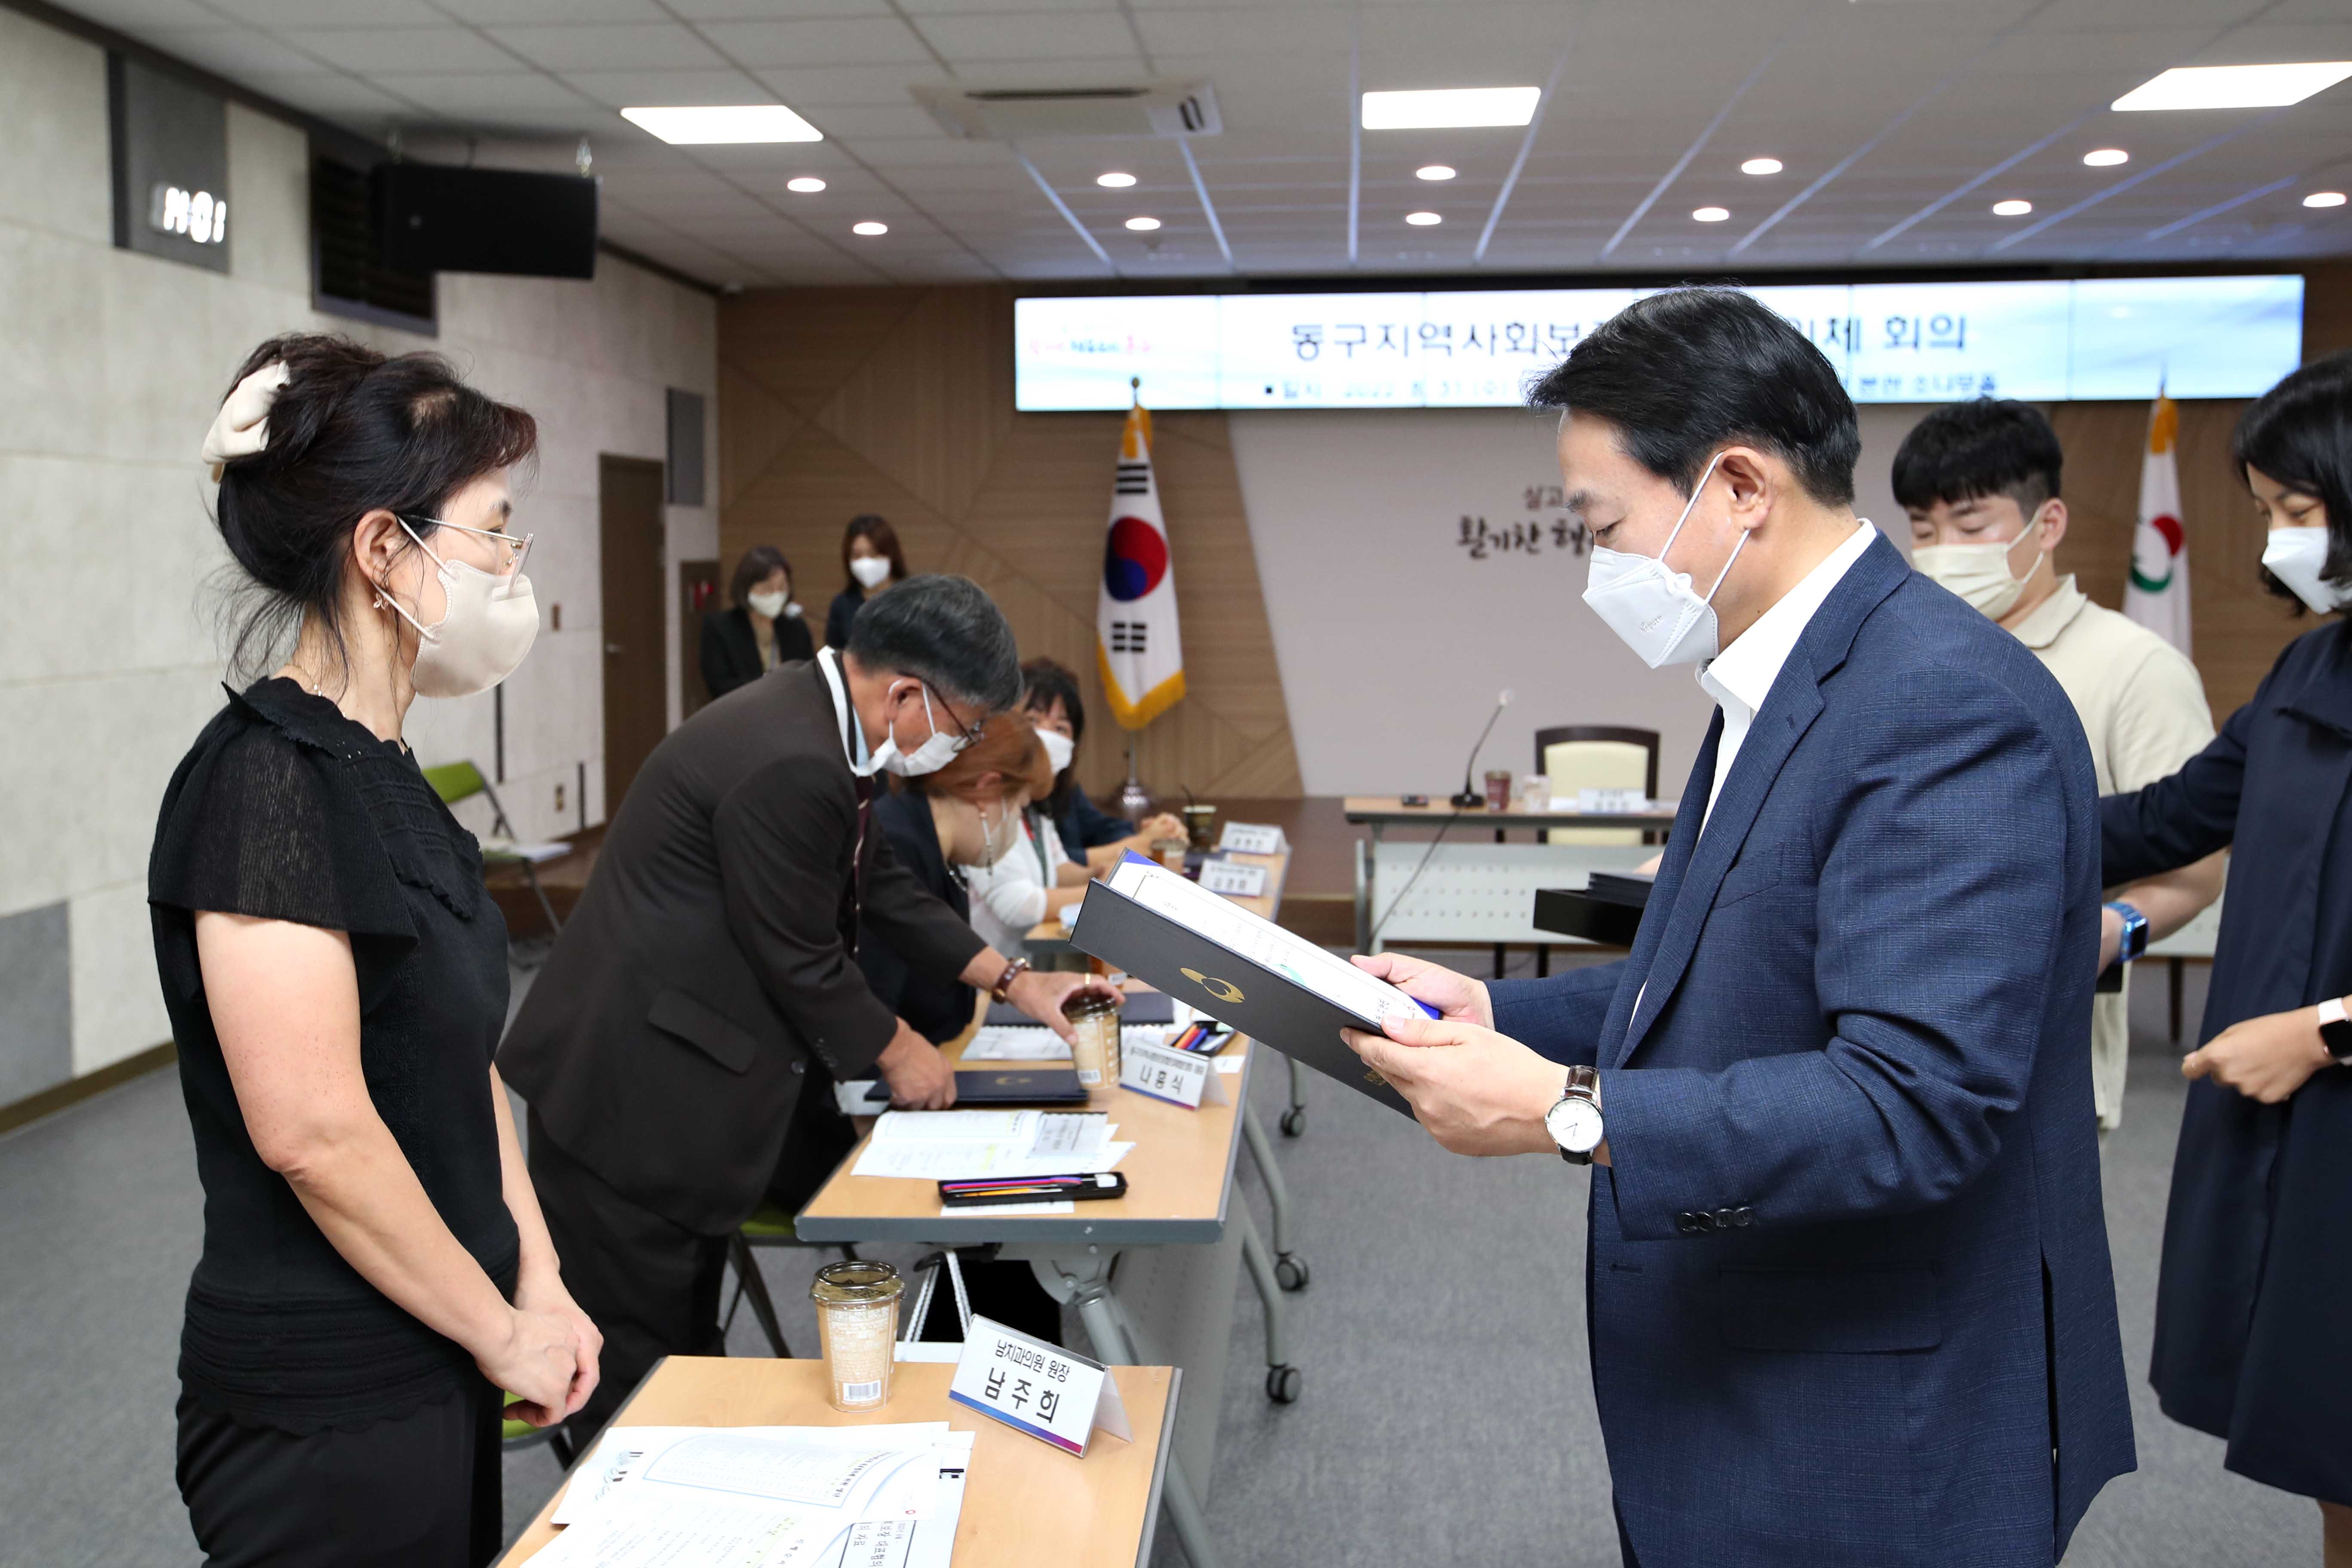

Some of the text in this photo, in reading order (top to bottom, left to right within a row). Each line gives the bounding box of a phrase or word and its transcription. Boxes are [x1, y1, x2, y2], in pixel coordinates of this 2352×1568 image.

[1292, 320, 1605, 361] 동구지역사회보
[1885, 315, 1966, 349] 회의
[995, 1339, 1070, 1383] 남치과의원 원장
[984, 1367, 1060, 1424] 남주희
